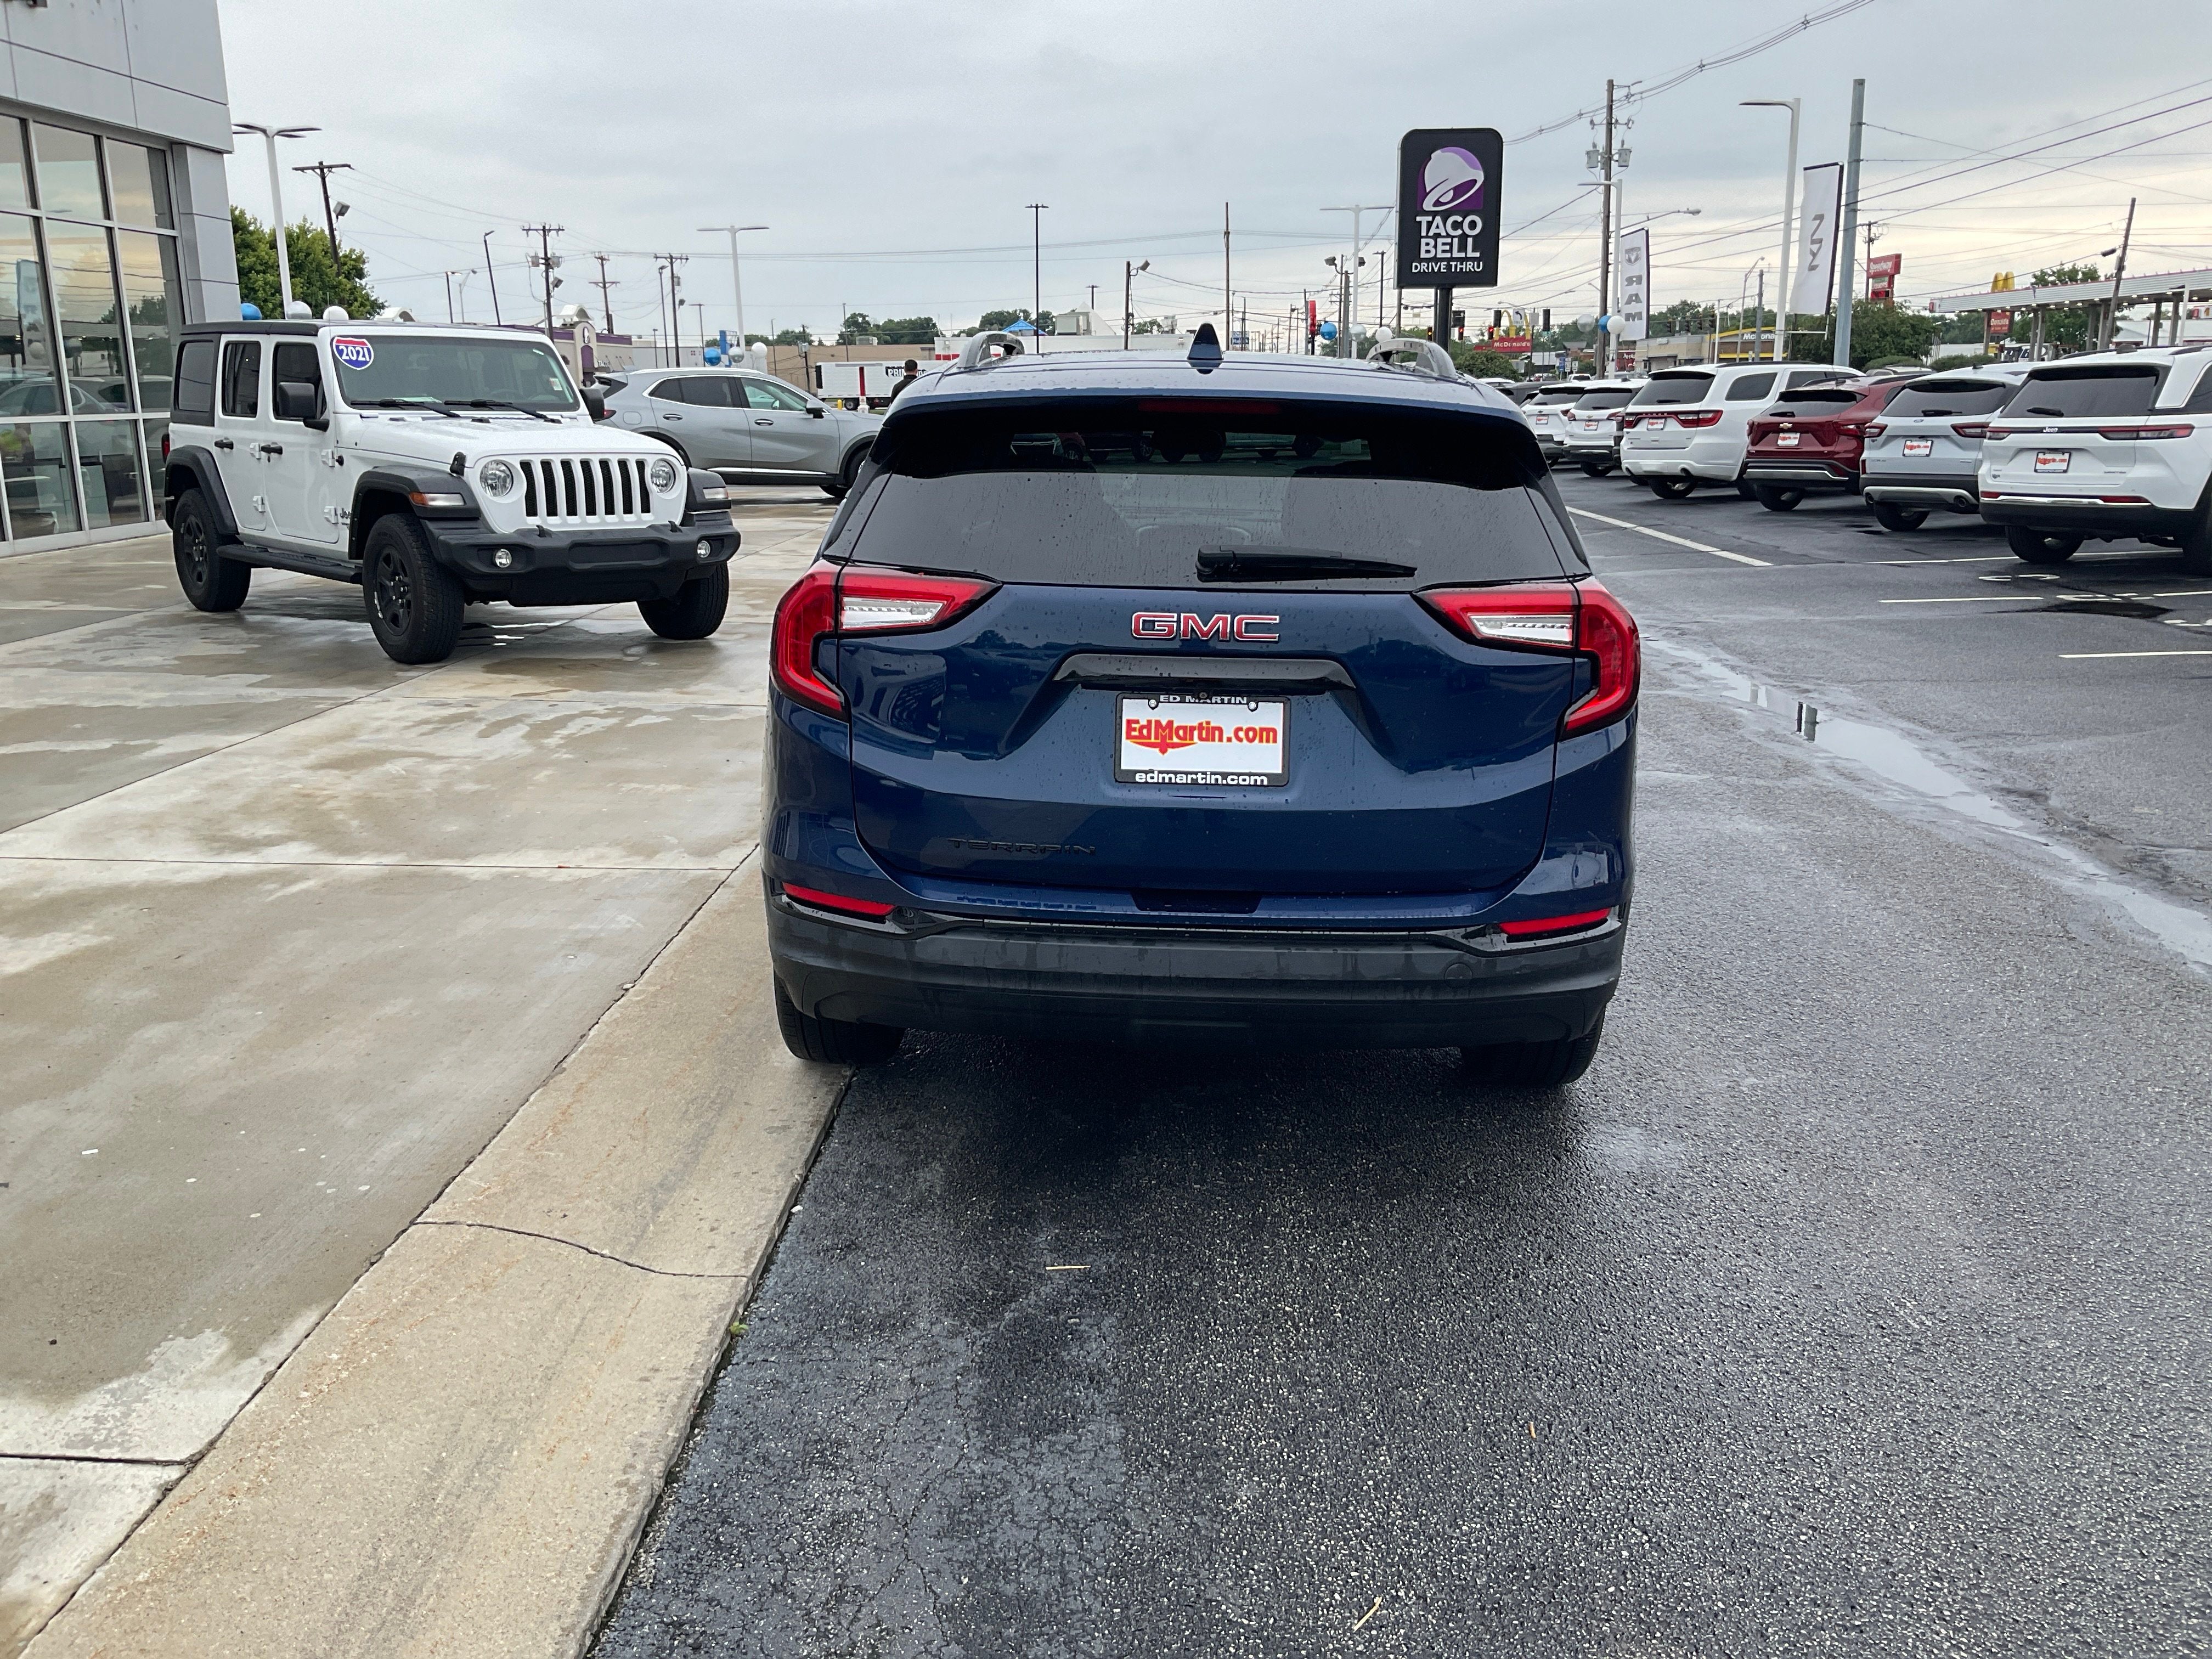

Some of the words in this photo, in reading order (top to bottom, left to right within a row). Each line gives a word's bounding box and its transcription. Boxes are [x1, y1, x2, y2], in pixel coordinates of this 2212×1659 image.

[1415, 215, 1482, 236] TACO
[1420, 237, 1480, 258] BELL
[1412, 262, 1447, 273] DRIVE
[1449, 261, 1483, 272] THRU
[338, 345, 370, 362] 2021
[1132, 612, 1280, 641] GMC
[1159, 695, 1180, 703] ED
[1125, 718, 1278, 754] EdMartin.com
[1135, 770, 1268, 785] edmartin.com
[946, 838, 1096, 855] TERRAIN
